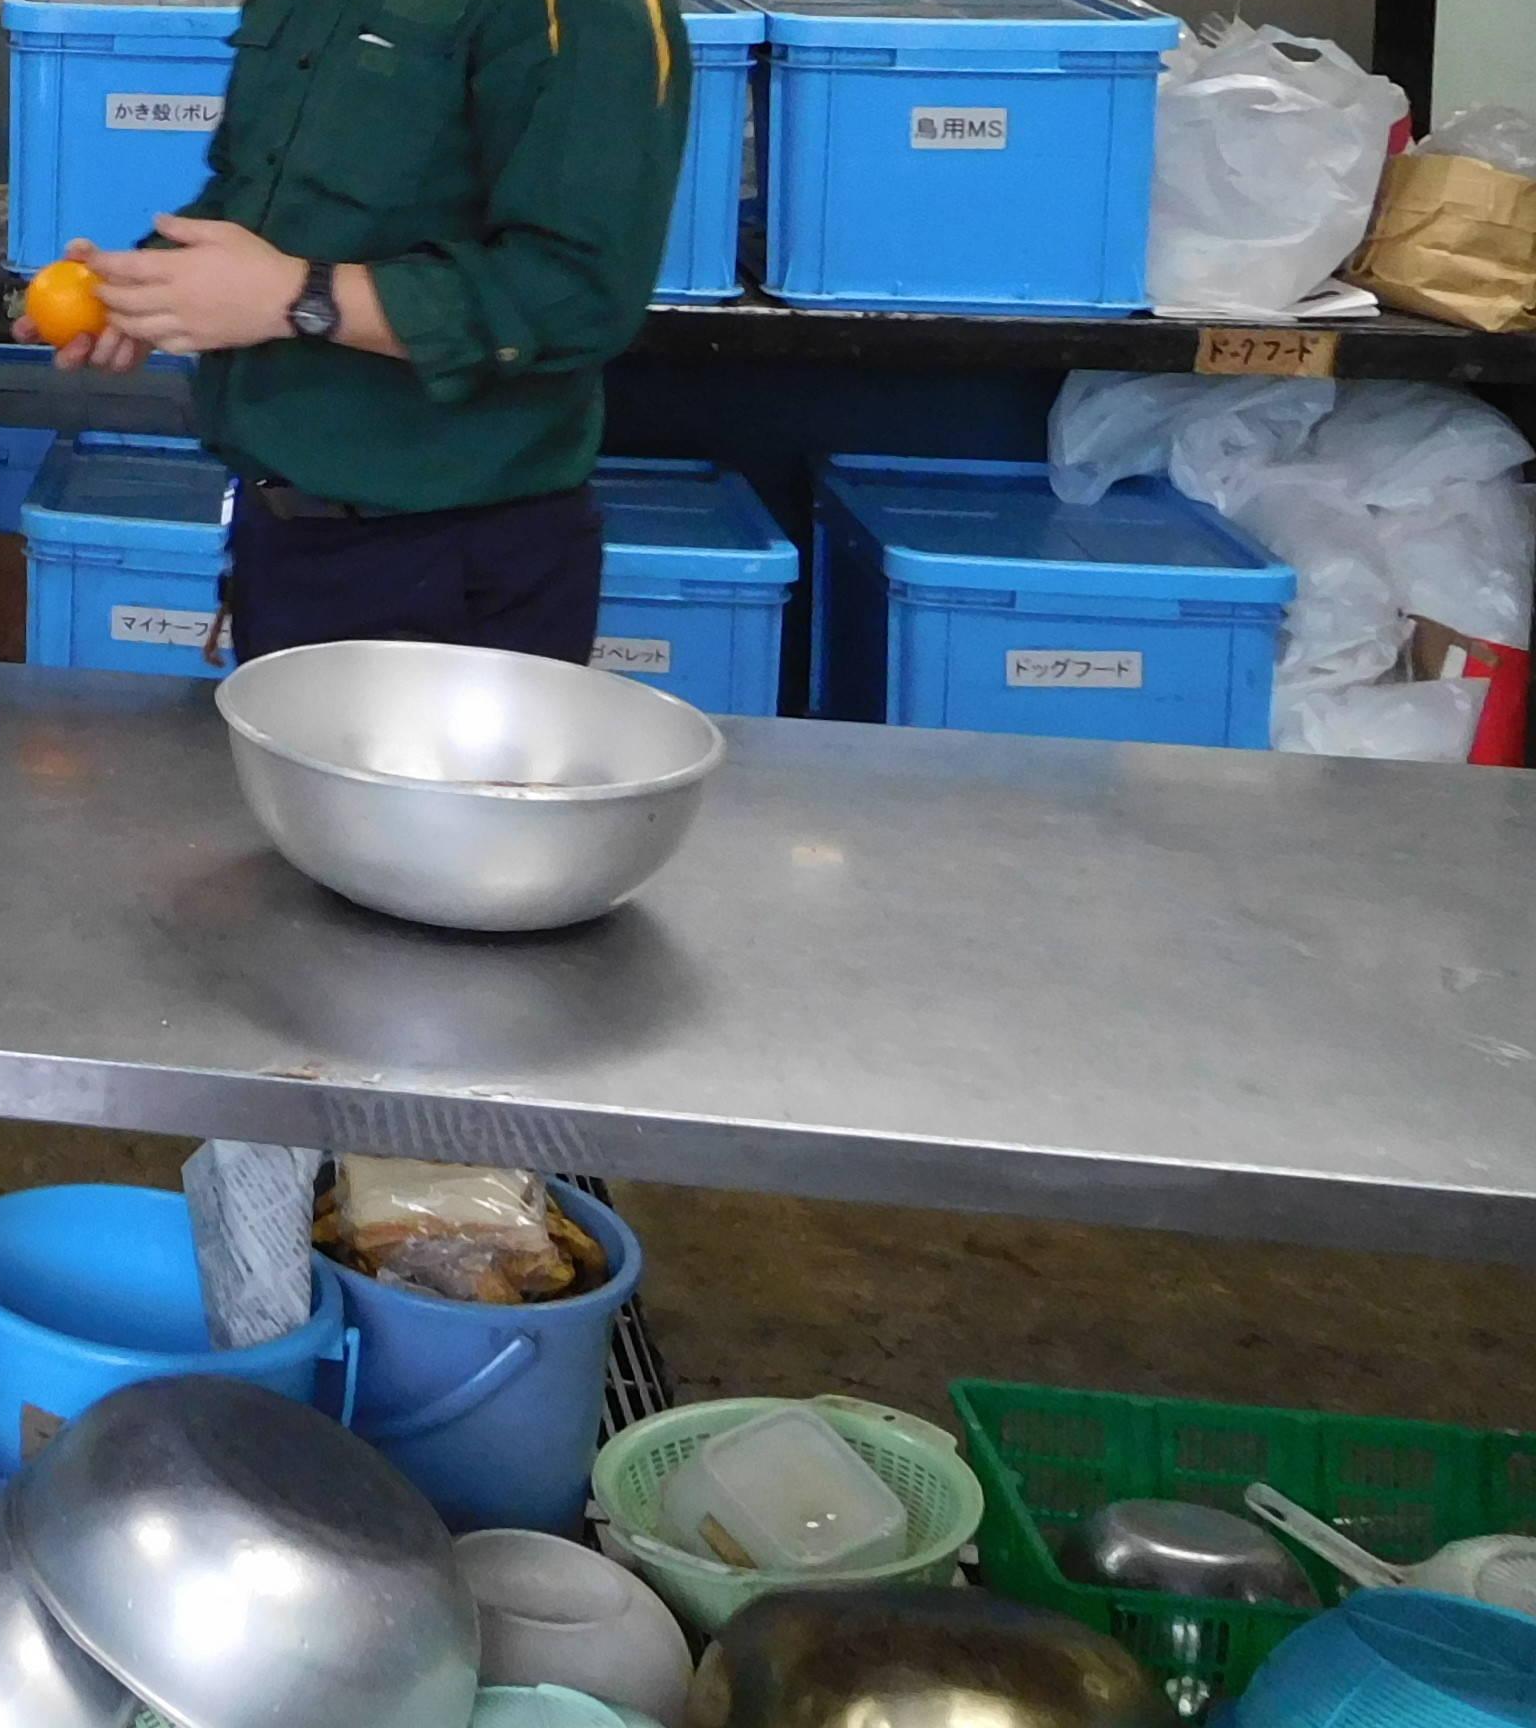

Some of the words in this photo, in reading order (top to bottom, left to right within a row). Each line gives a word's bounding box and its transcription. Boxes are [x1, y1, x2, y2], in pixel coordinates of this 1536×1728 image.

[114, 103, 226, 122] かき殻(ボレ
[915, 117, 1004, 140] 鳥用MS
[590, 644, 665, 663] ゴペレット
